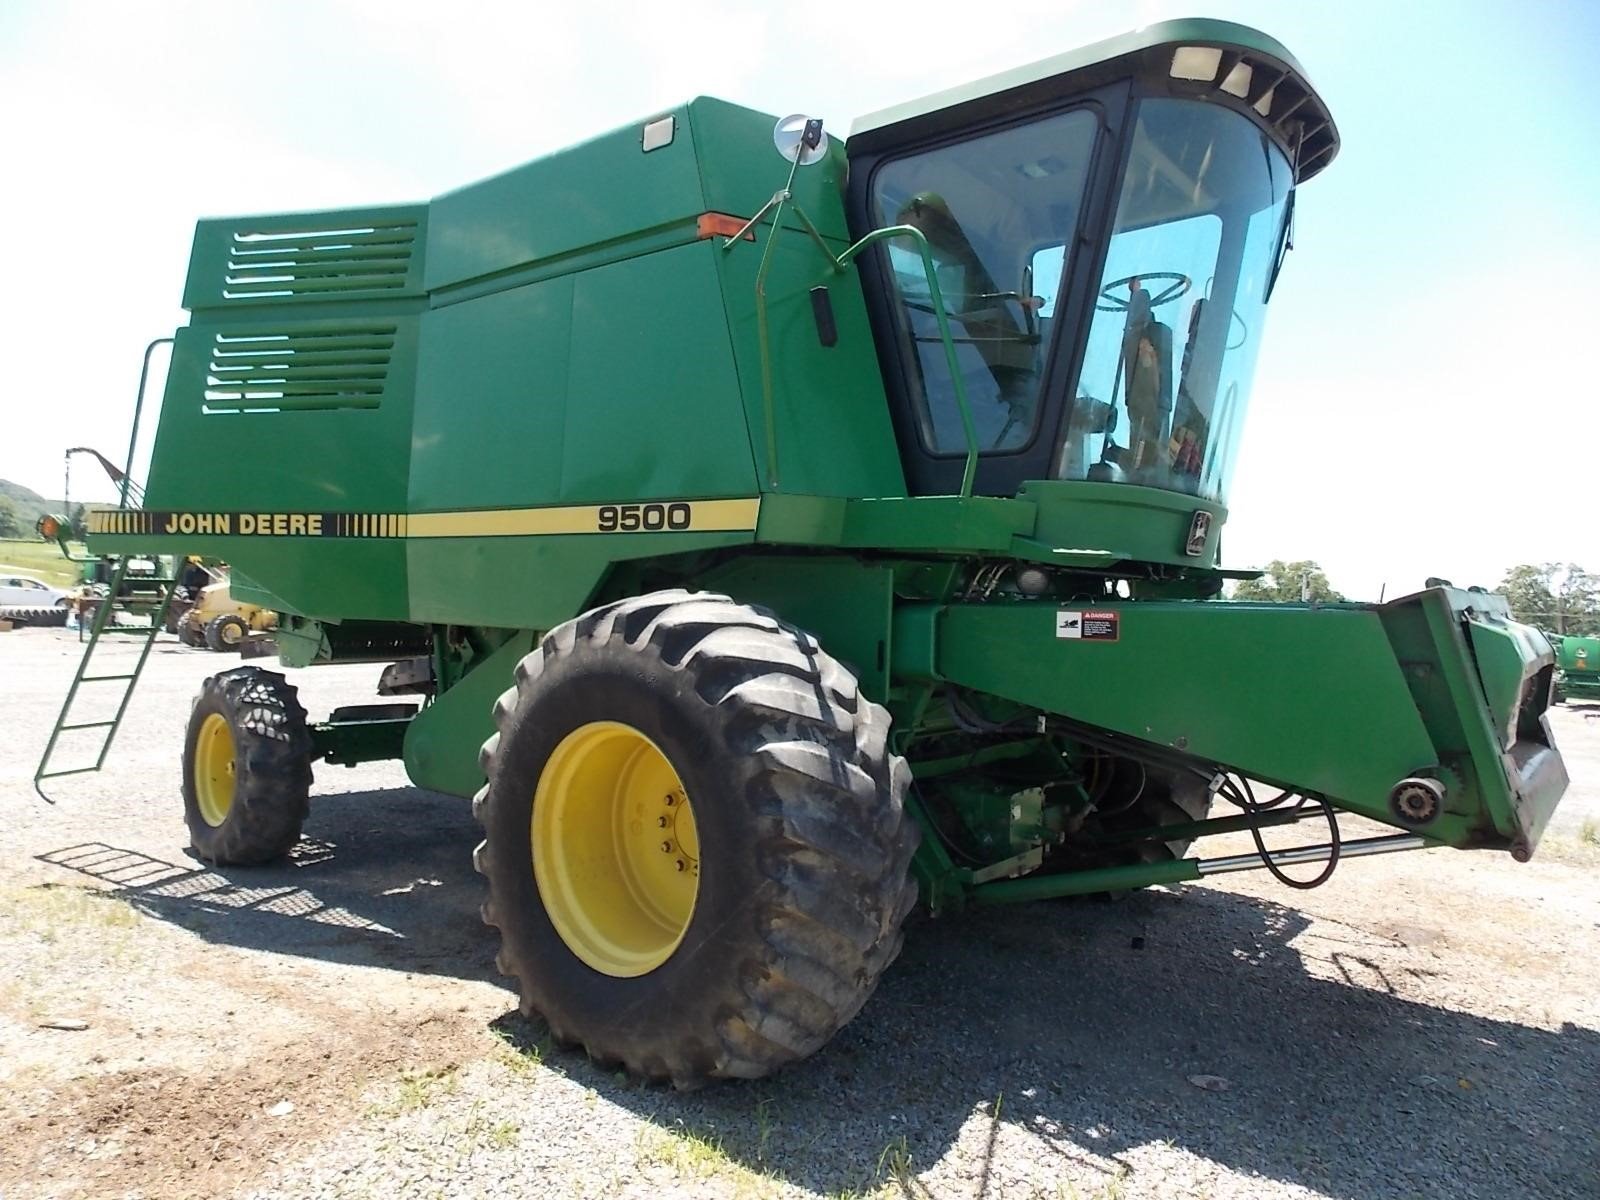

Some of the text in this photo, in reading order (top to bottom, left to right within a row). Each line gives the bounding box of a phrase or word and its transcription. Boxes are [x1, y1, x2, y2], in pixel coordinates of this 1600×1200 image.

[165, 513, 323, 535] JOHN DEERE
[598, 503, 691, 531] 9500
